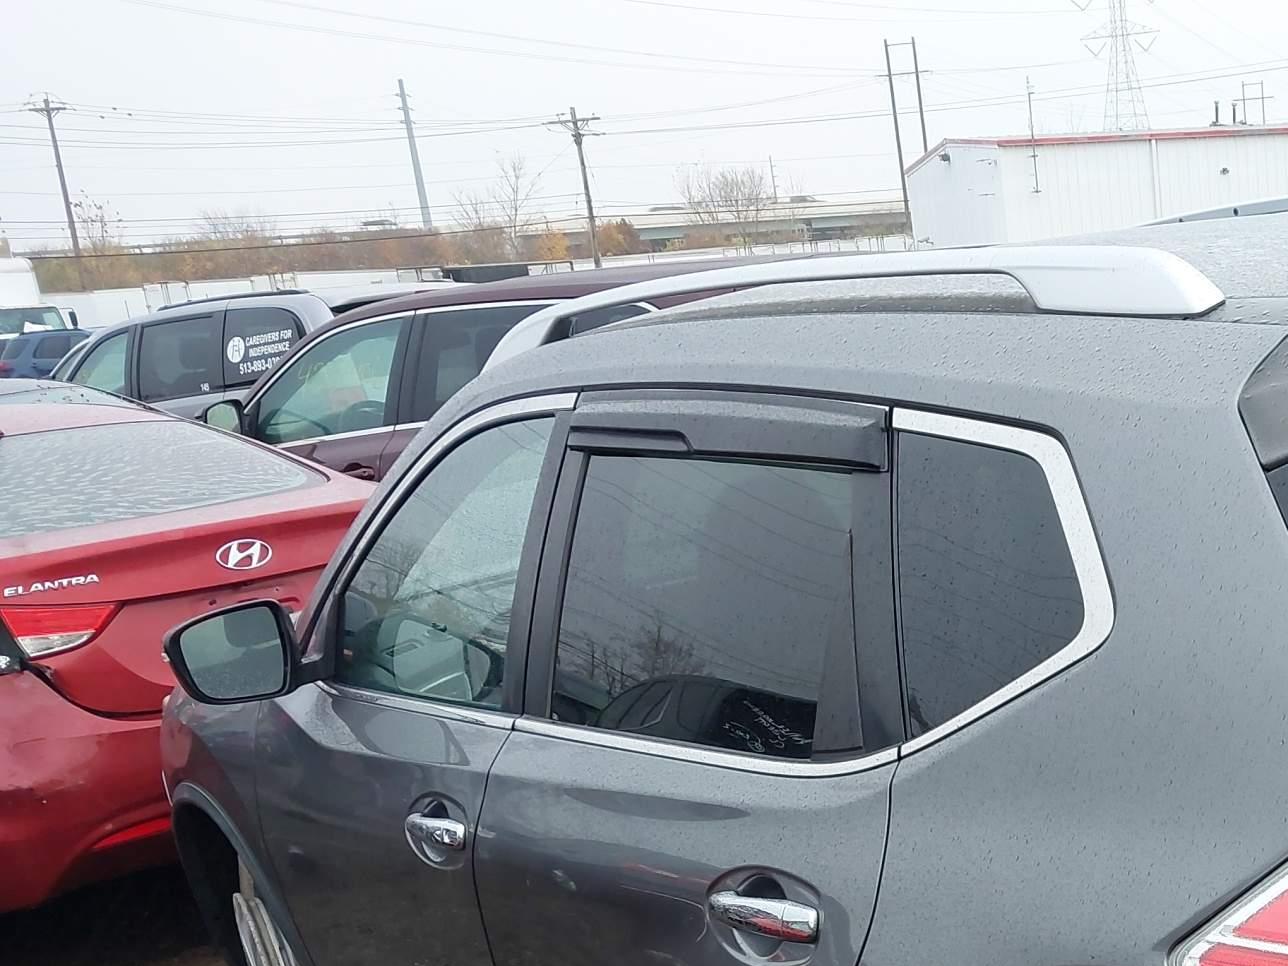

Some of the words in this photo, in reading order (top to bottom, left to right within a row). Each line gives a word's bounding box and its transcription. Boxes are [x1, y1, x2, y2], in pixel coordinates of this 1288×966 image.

[245, 331, 280, 346] CAREGIVERS
[280, 329, 293, 340] FOR
[248, 341, 290, 358] INDEPENDENCE
[239, 356, 284, 375] 513-893-0
[3, 574, 100, 597] ELANTRA
